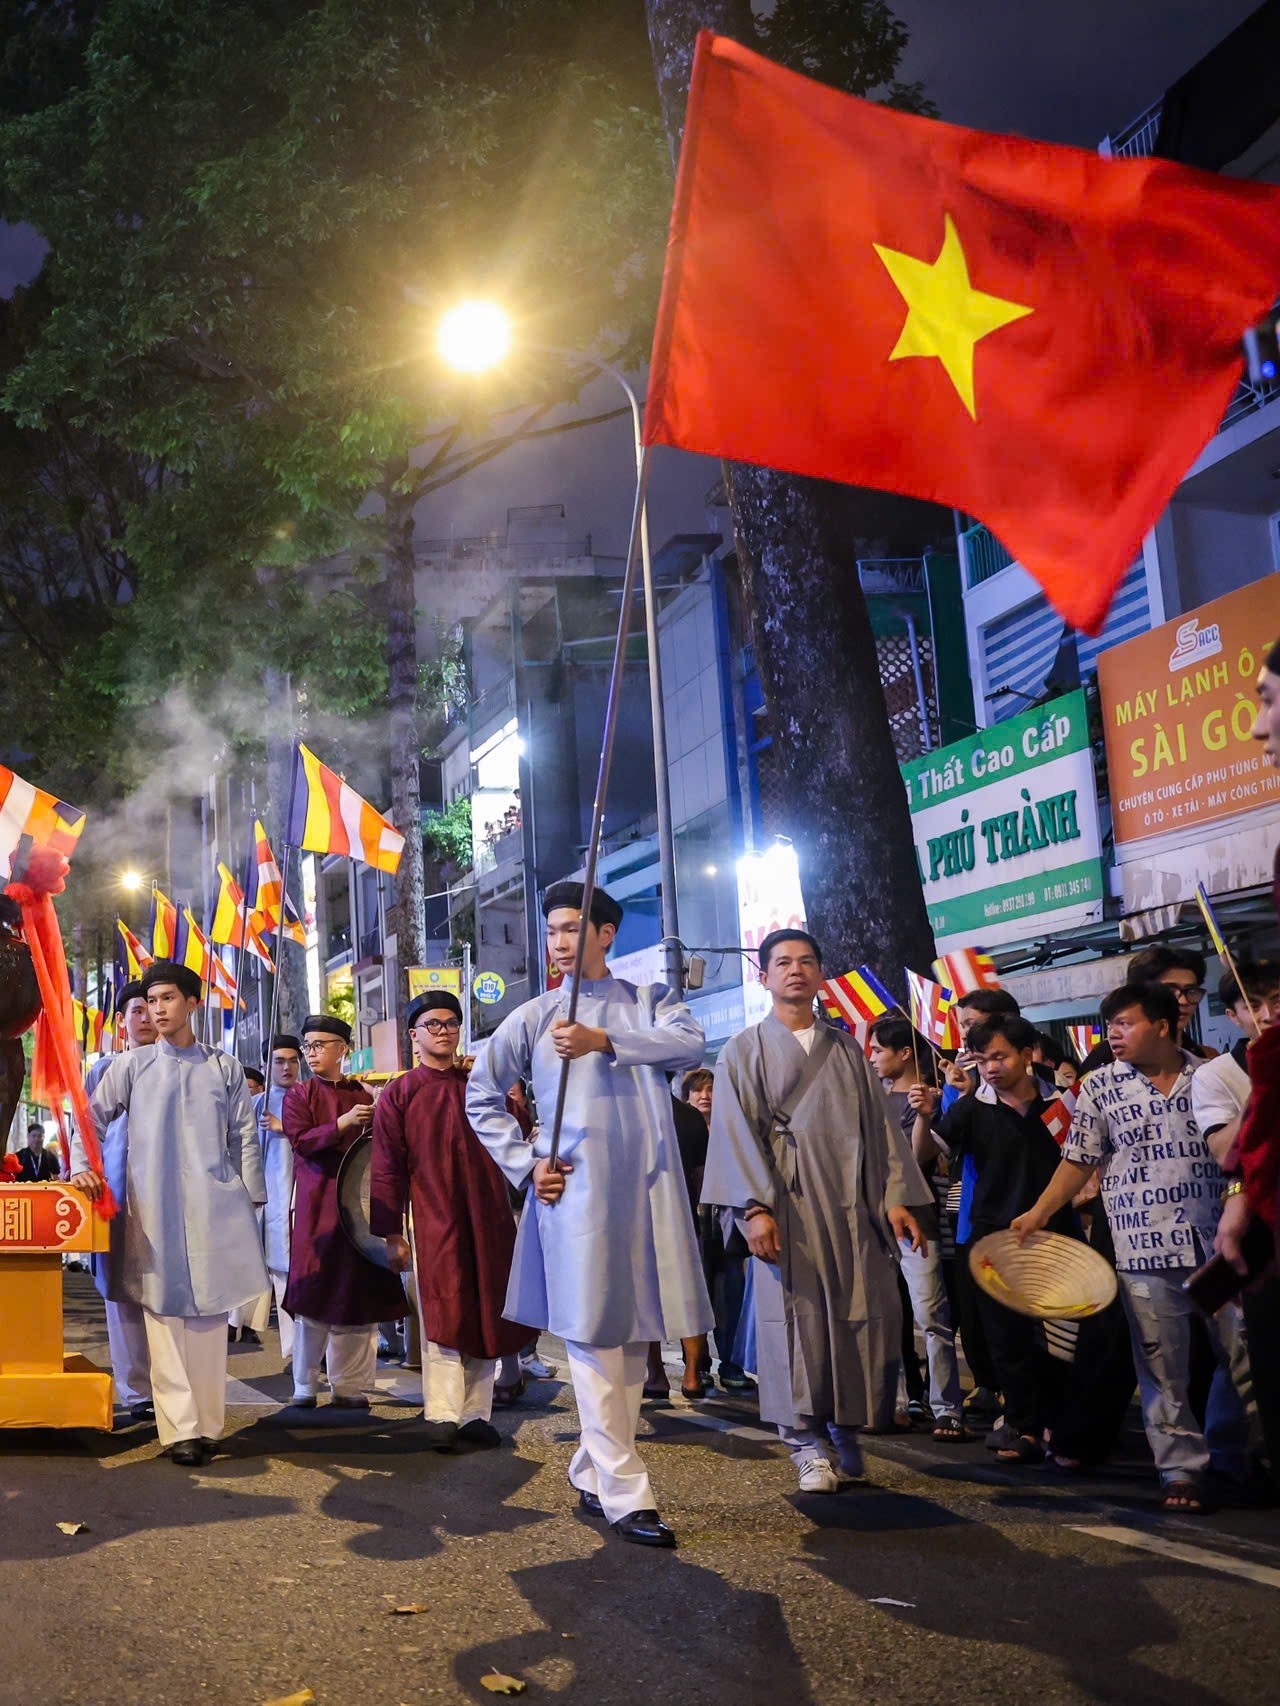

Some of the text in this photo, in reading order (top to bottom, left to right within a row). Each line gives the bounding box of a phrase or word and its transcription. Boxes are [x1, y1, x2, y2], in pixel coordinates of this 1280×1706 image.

[1116, 689, 1158, 726] MÁY
[1167, 661, 1229, 706] LẠNH
[1238, 648, 1255, 677] Ô
[917, 755, 964, 800] Thất
[972, 744, 1015, 778] Cao
[1022, 713, 1071, 759] Cấp
[1131, 693, 1259, 778] SÀI GÒ
[1119, 790, 1154, 812] CHUYÊN
[1157, 782, 1182, 800] CUNG
[1185, 773, 1203, 792] CẤP
[1206, 767, 1227, 784] PHỤ
[1229, 757, 1258, 777] TÙNG
[1144, 812, 1151, 826] Ô
[1152, 808, 1164, 823] TÔ
[1172, 804, 1183, 818] XE
[1184, 798, 1199, 814] TẢI
[1208, 791, 1227, 808] MÁY
[1230, 782, 1258, 800] CÔNG
[927, 809, 976, 881] PHÚ
[981, 787, 1081, 864] THÀNH
[1174, 1207, 1185, 1224] 2
